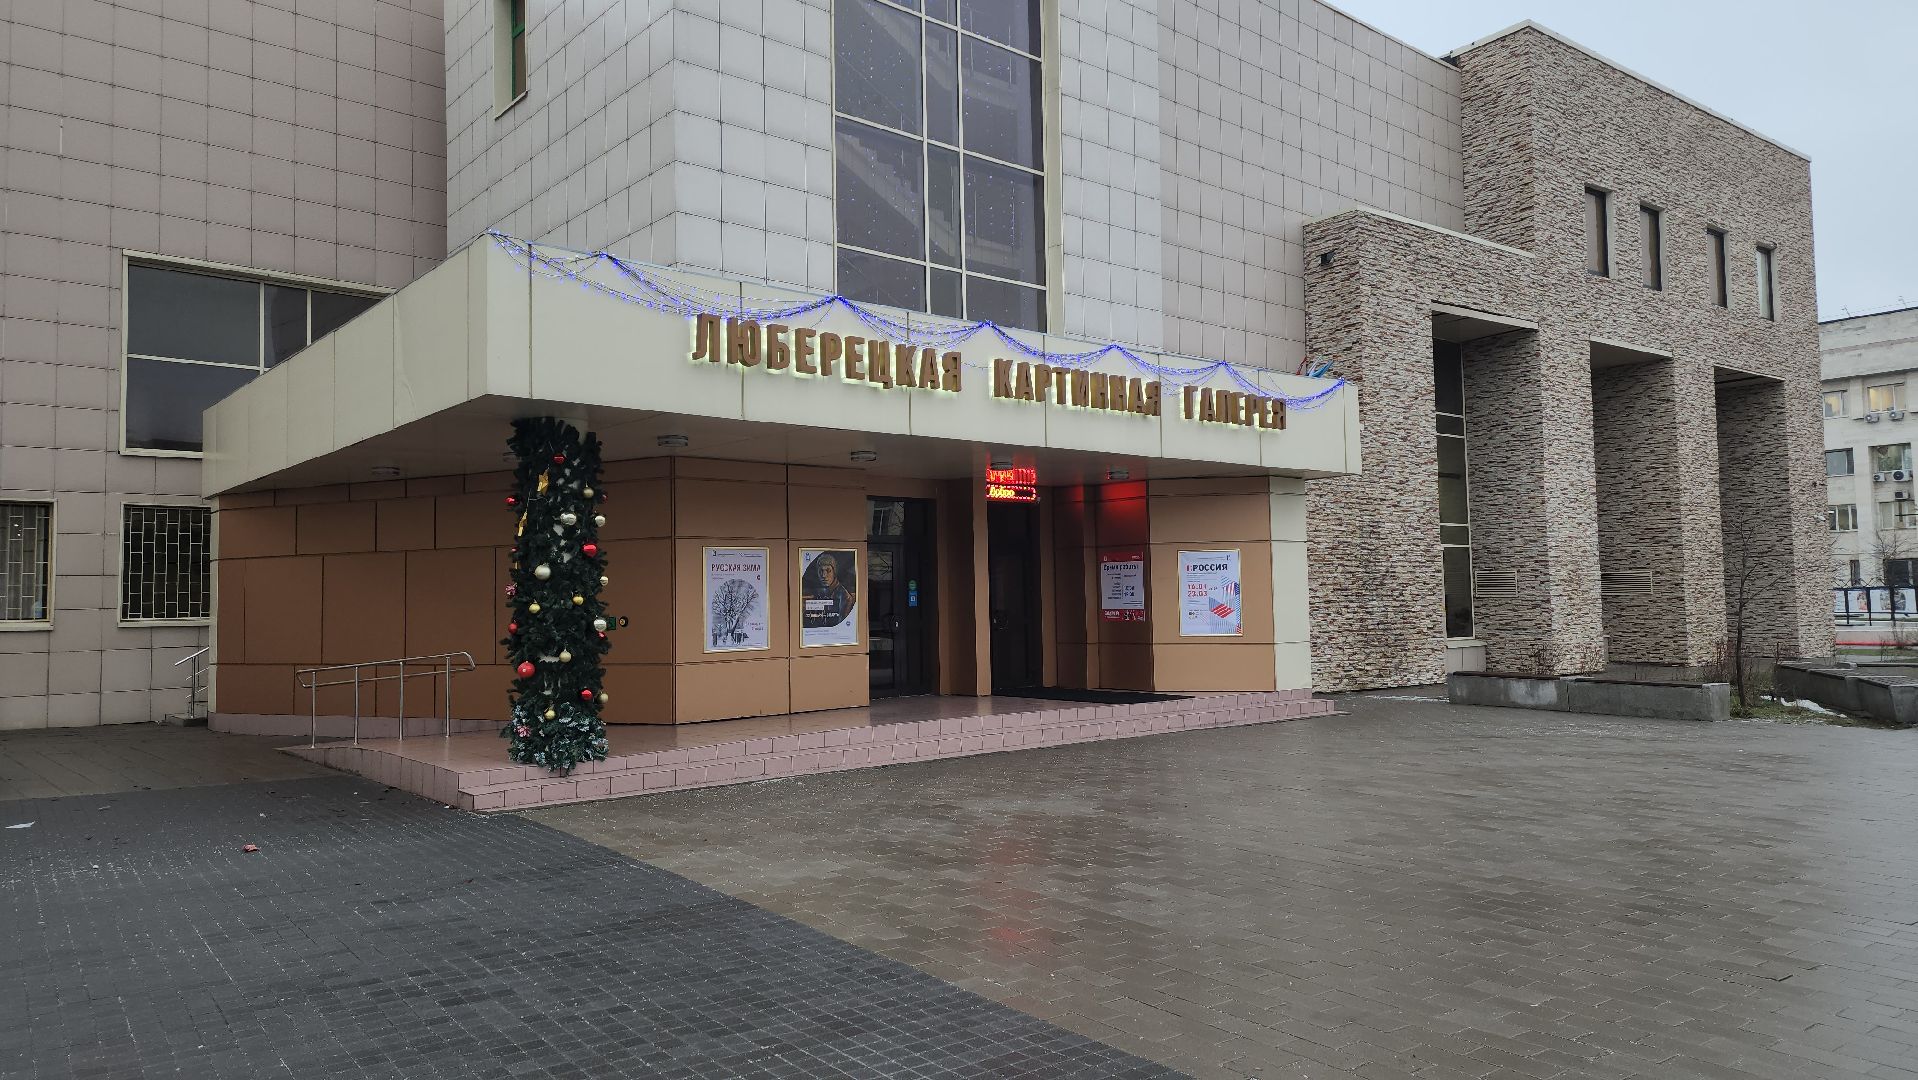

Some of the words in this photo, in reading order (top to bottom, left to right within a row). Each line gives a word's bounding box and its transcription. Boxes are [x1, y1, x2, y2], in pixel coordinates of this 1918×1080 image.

[692, 312, 962, 392] ЛЮБЕРЕЦКАЯ
[993, 358, 1161, 416] КАРТИННАЯ
[1183, 385, 1287, 430] ГАЛЕРЕЯ
[711, 563, 740, 572] РУССКАЯ
